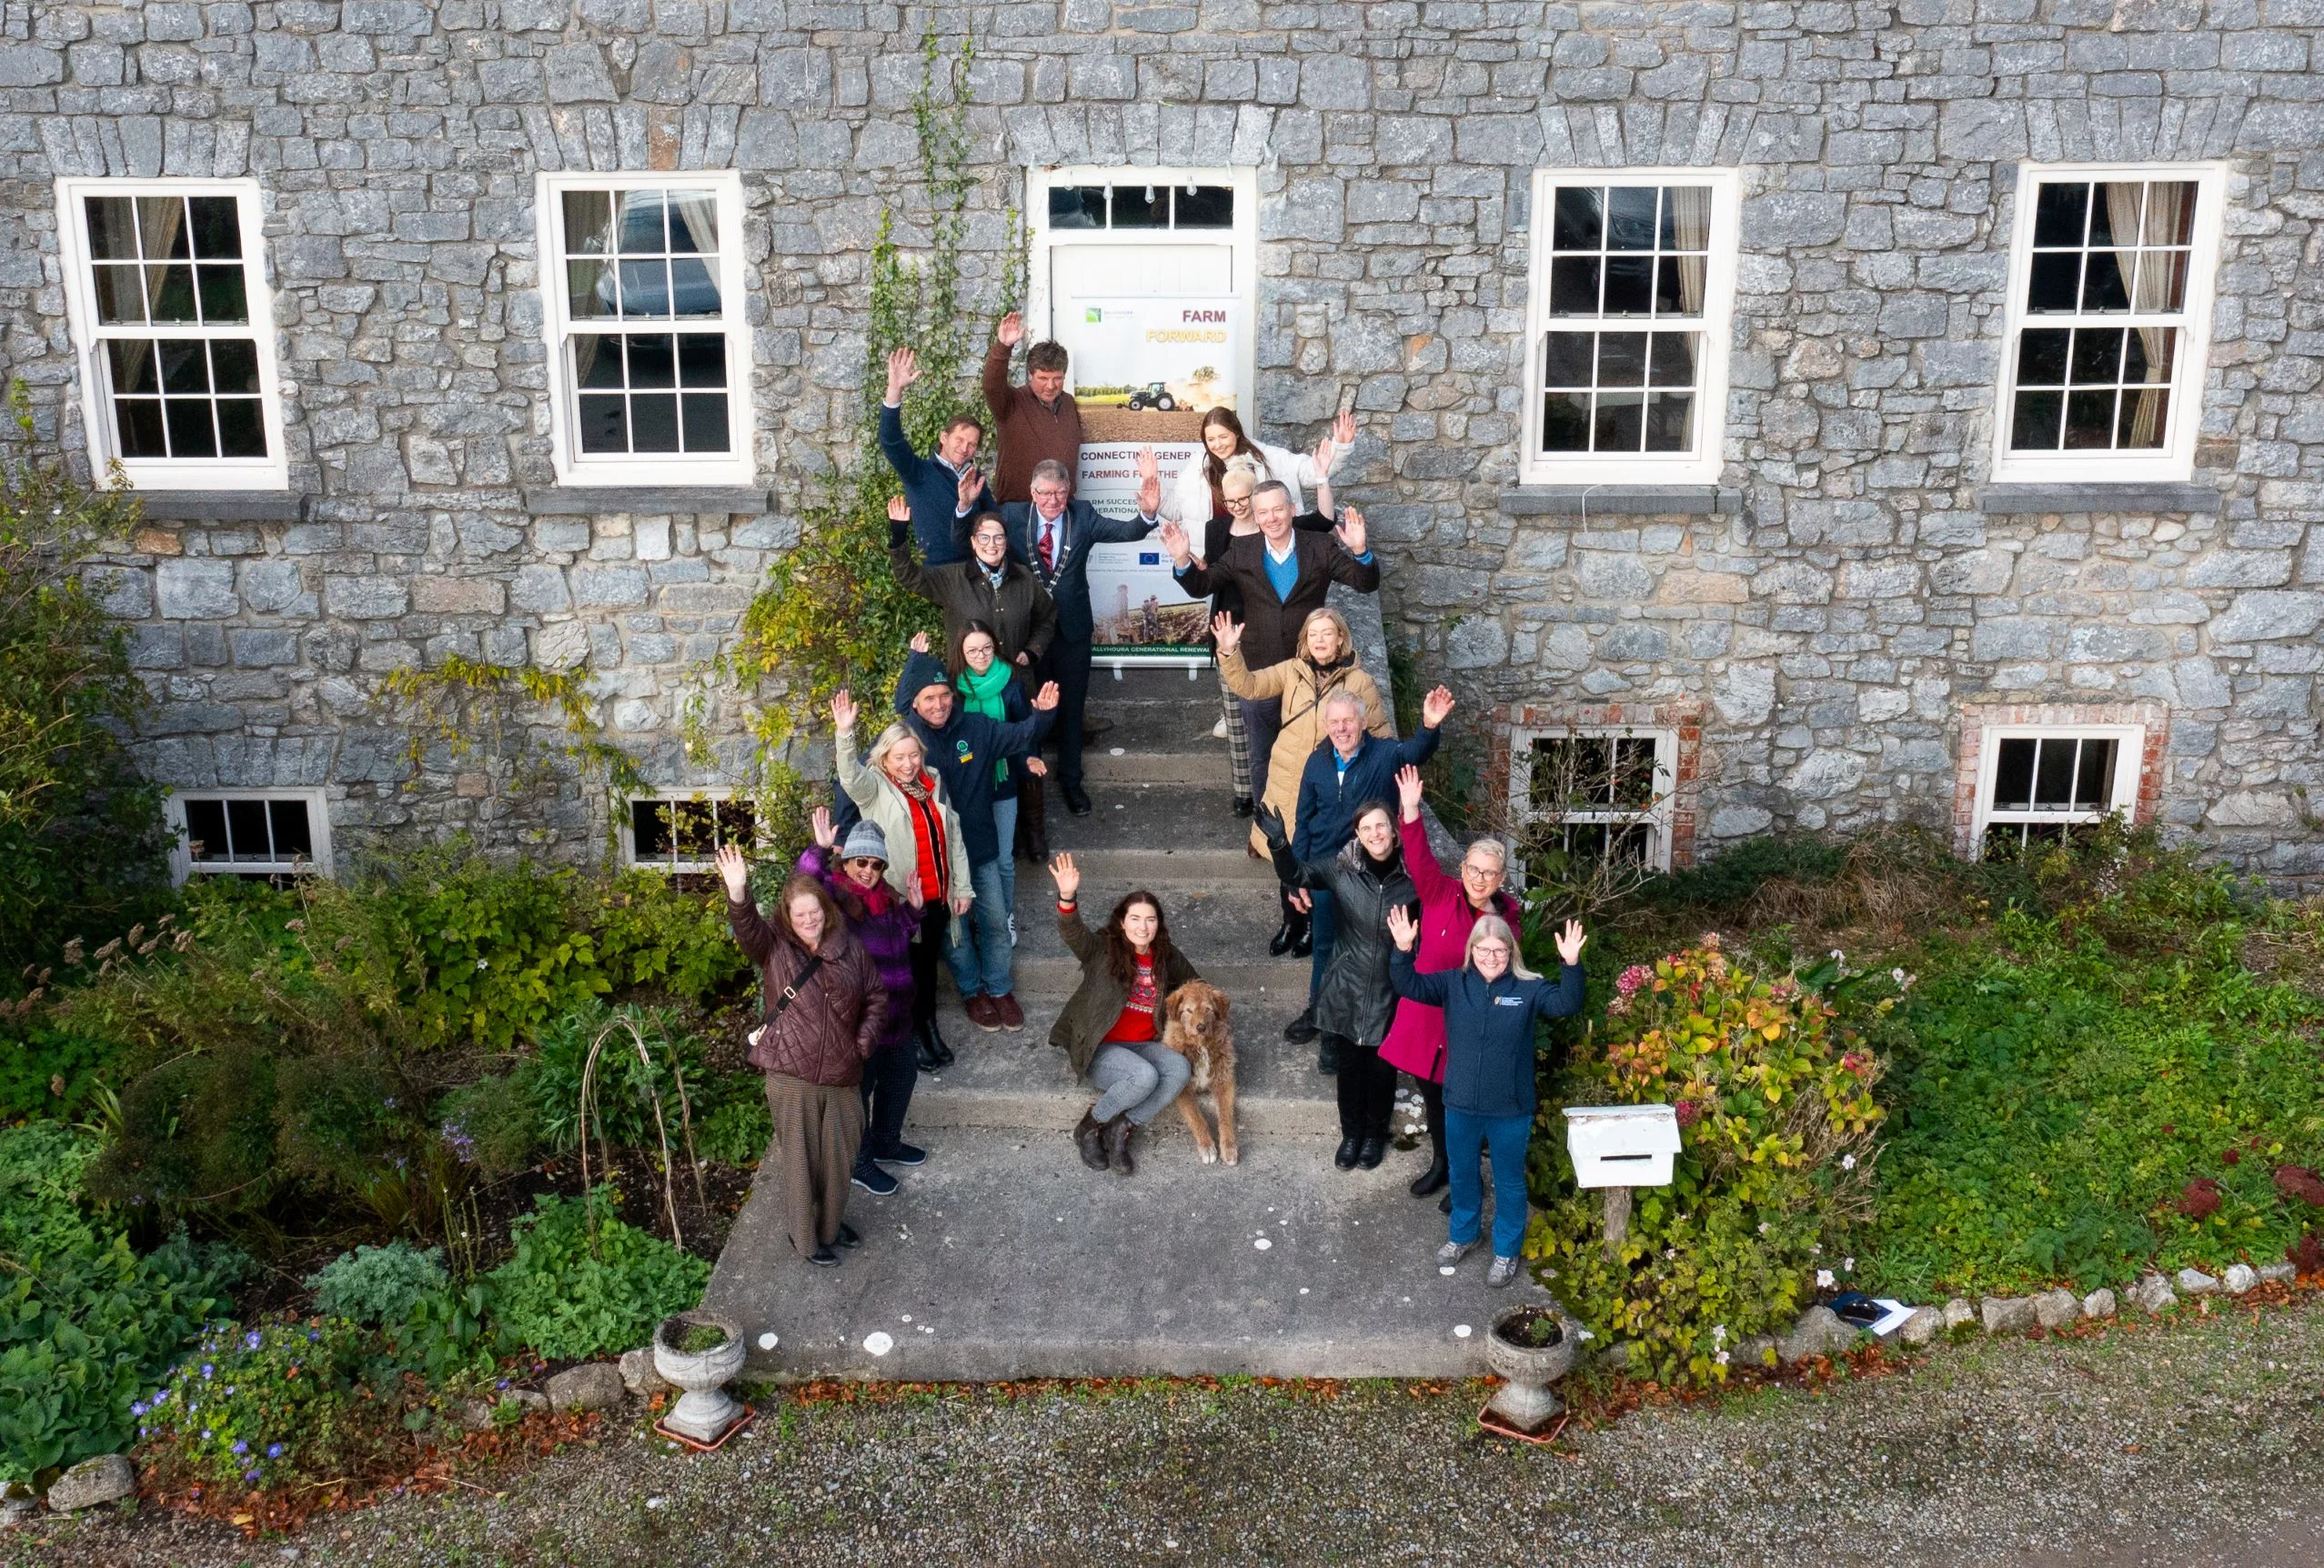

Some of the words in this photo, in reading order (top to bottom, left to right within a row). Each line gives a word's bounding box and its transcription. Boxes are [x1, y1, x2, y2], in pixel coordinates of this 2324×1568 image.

[1182, 310, 1226, 322] FARM
[1146, 329, 1227, 343] FORWARD
[1081, 451, 1150, 460] CONNECTIN
[1155, 451, 1192, 460] GENER
[1082, 469, 1129, 479] FARMING
[1158, 470, 1178, 478] THE
